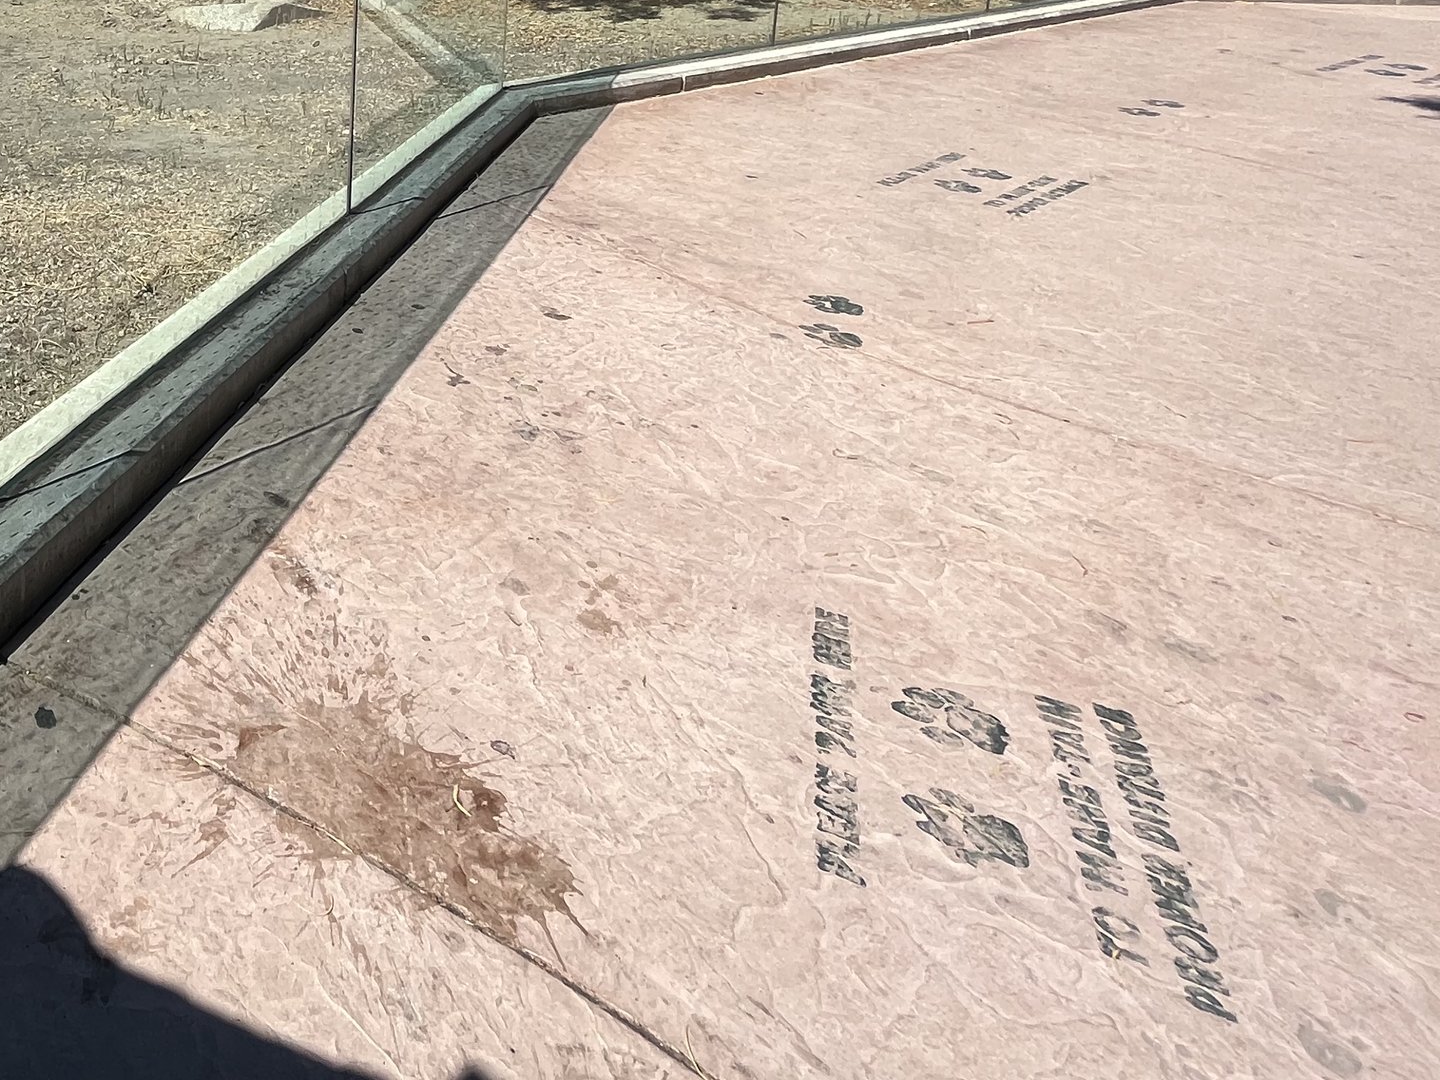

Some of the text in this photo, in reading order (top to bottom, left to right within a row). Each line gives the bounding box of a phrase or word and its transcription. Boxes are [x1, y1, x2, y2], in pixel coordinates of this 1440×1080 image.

[1091, 702, 1238, 1023] PROPER DISTANCE
[1091, 906, 1150, 968] TO
